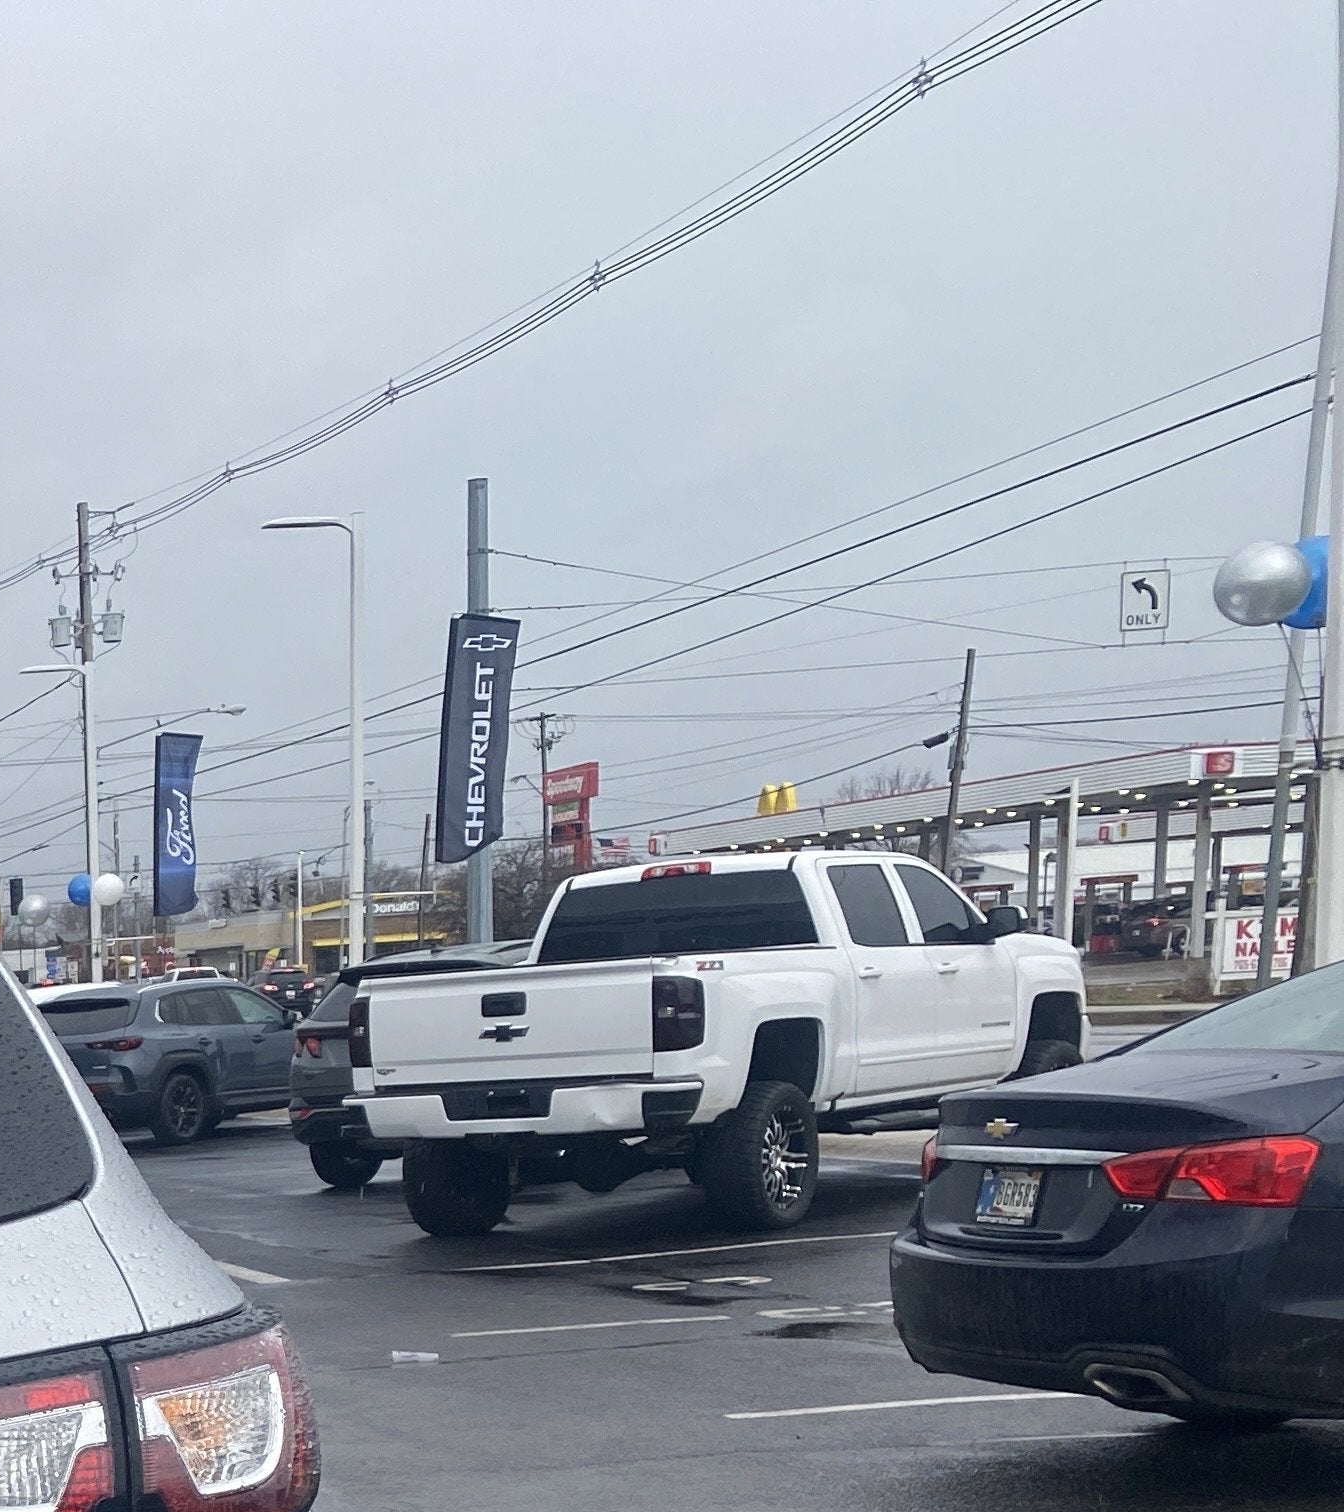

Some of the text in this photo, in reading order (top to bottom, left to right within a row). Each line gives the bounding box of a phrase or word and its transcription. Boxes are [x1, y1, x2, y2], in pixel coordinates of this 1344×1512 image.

[1125, 613, 1162, 626] ONLY
[464, 661, 495, 847] CHEVROLET
[166, 788, 195, 866] Ford
[1236, 916, 1299, 940] KM
[1235, 940, 1296, 957] NALS
